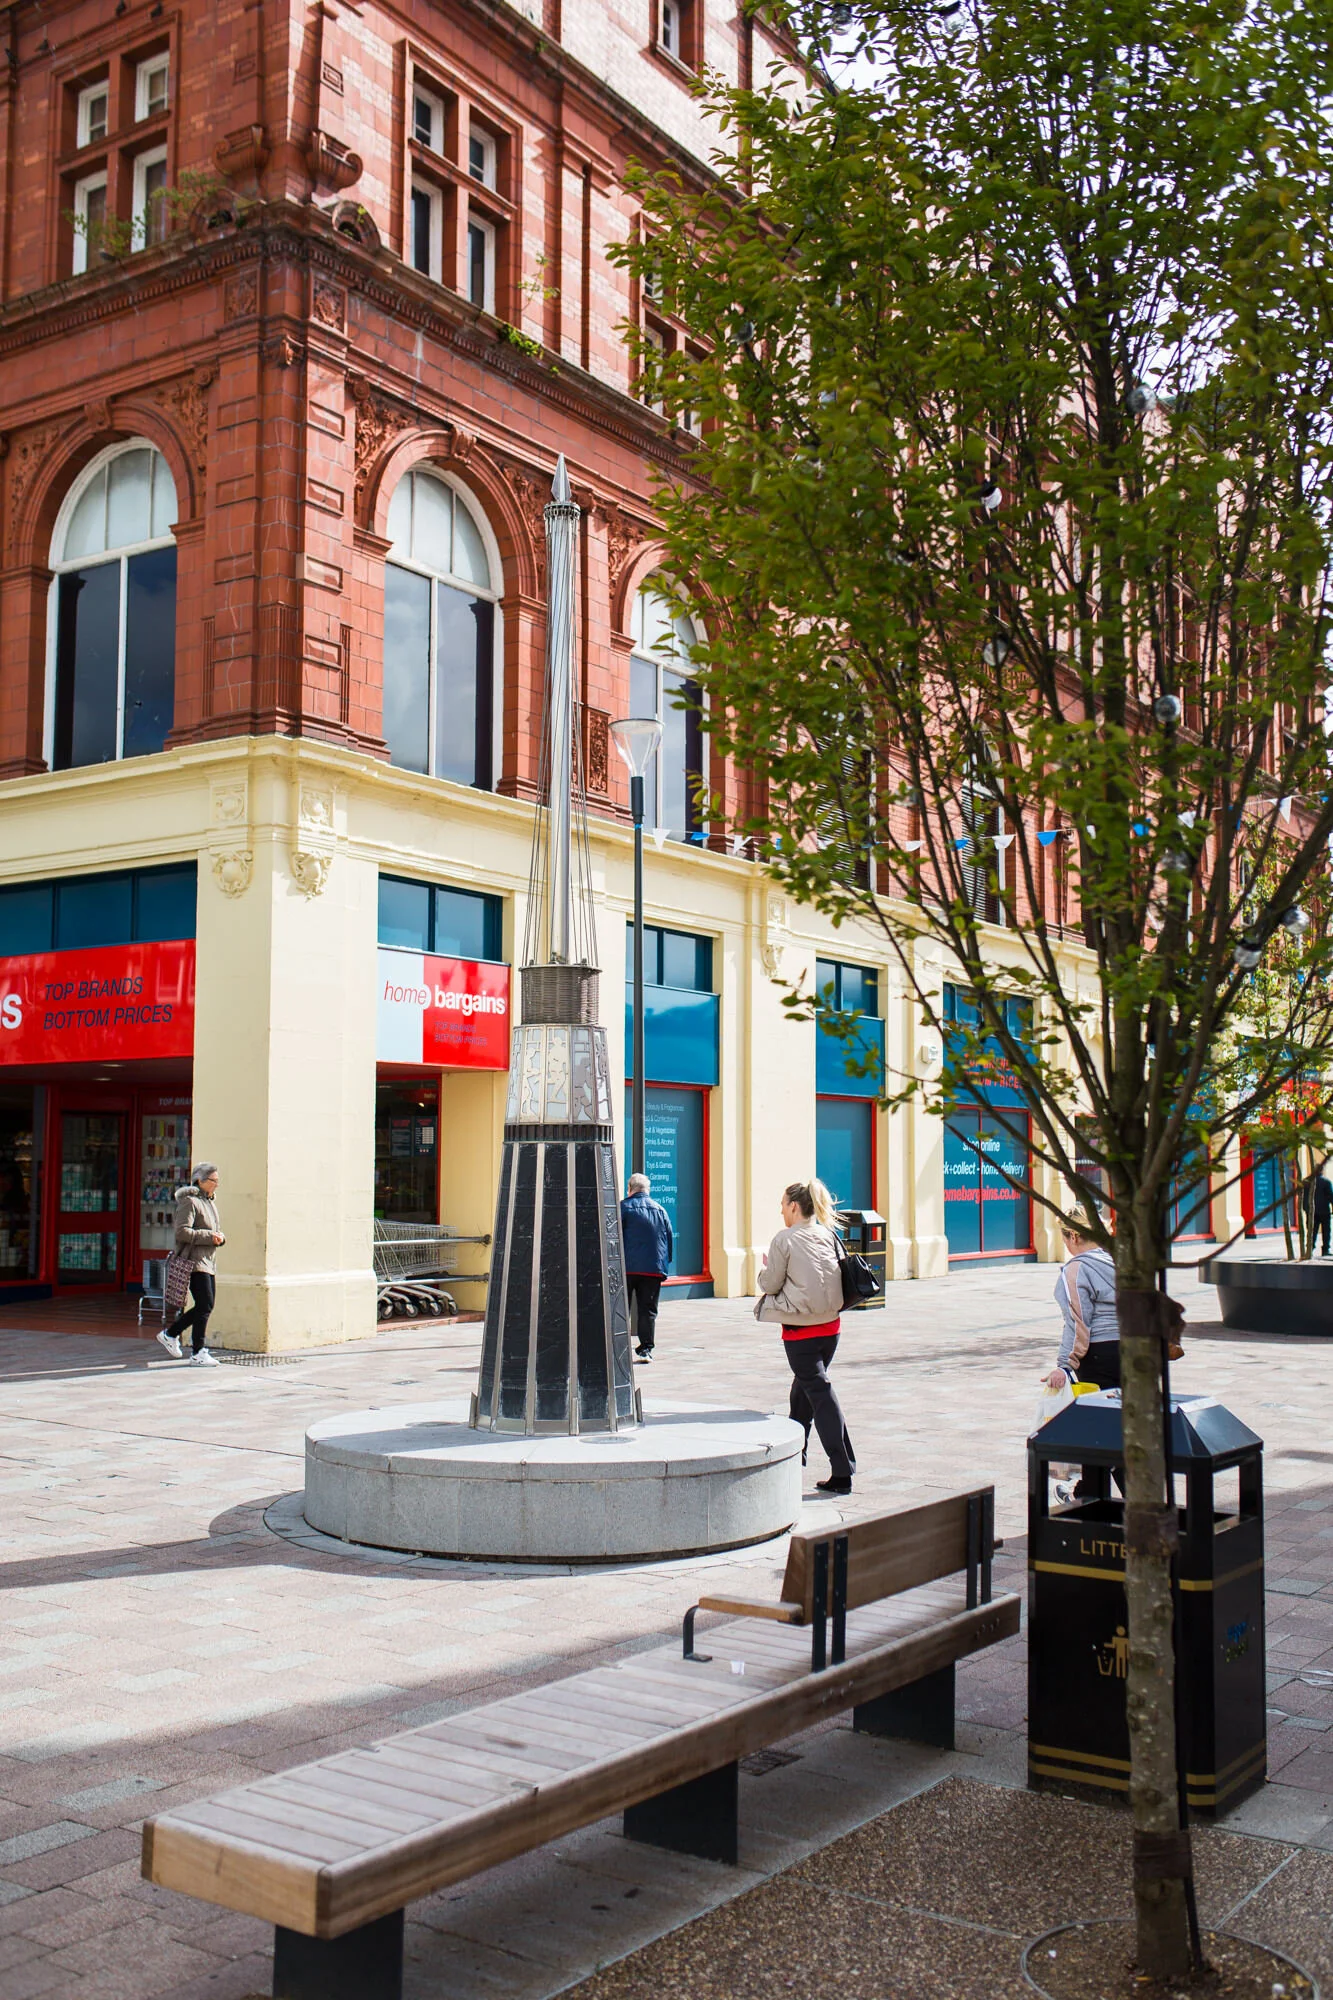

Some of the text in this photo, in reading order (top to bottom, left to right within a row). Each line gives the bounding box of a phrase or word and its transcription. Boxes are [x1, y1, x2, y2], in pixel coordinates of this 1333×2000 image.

[44, 977, 144, 1001] TOP BRANDS
[383, 980, 506, 1016] home bargains
[0, 993, 22, 1030] s
[43, 1004, 173, 1030] BOTTOM PRICES
[434, 1021, 477, 1033] TOP BRANDS
[434, 1033, 488, 1047] BOTTOM PRICES
[159, 1097, 173, 1106] TOP
[656, 1127, 676, 1135] Vegetables
[661, 1138, 674, 1146] Alcohol
[980, 1139, 1000, 1152] online
[648, 1150, 671, 1158] Homewares
[646, 1161, 655, 1170] Toys
[659, 1161, 673, 1169] Games
[1000, 1161, 1025, 1177] delivery
[650, 1173, 670, 1182] Gardening
[661, 1185, 677, 1193] Cleaning
[666, 1196, 676, 1206] Party
[1080, 1537, 1129, 1560] LITTE
